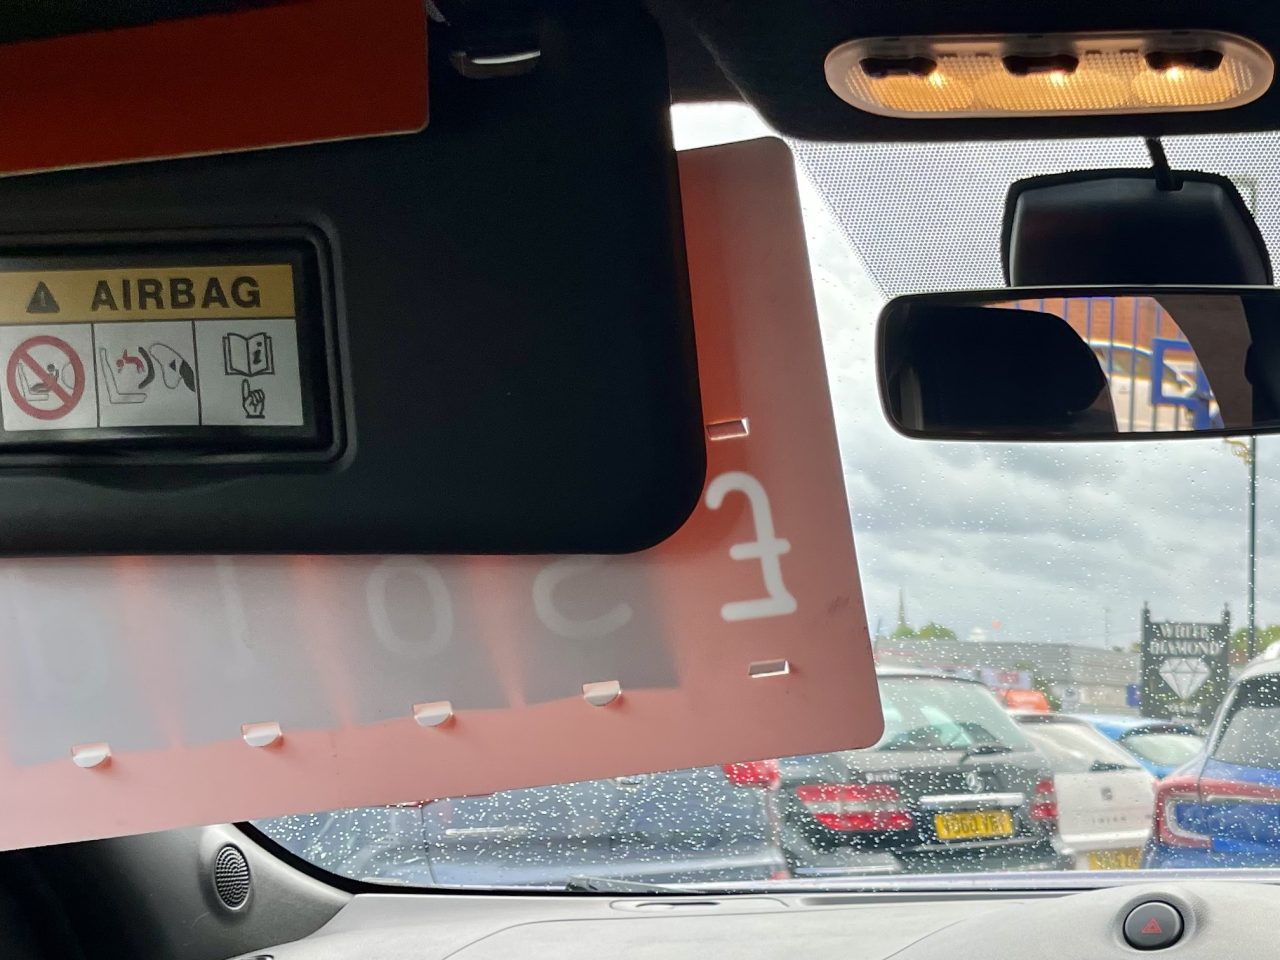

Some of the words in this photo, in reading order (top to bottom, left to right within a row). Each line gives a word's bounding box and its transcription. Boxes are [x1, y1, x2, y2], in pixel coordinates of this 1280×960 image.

[89, 275, 262, 313] AIRBAG
[1160, 624, 1210, 639] WHITE
[1149, 641, 1221, 656] DIAMOND
